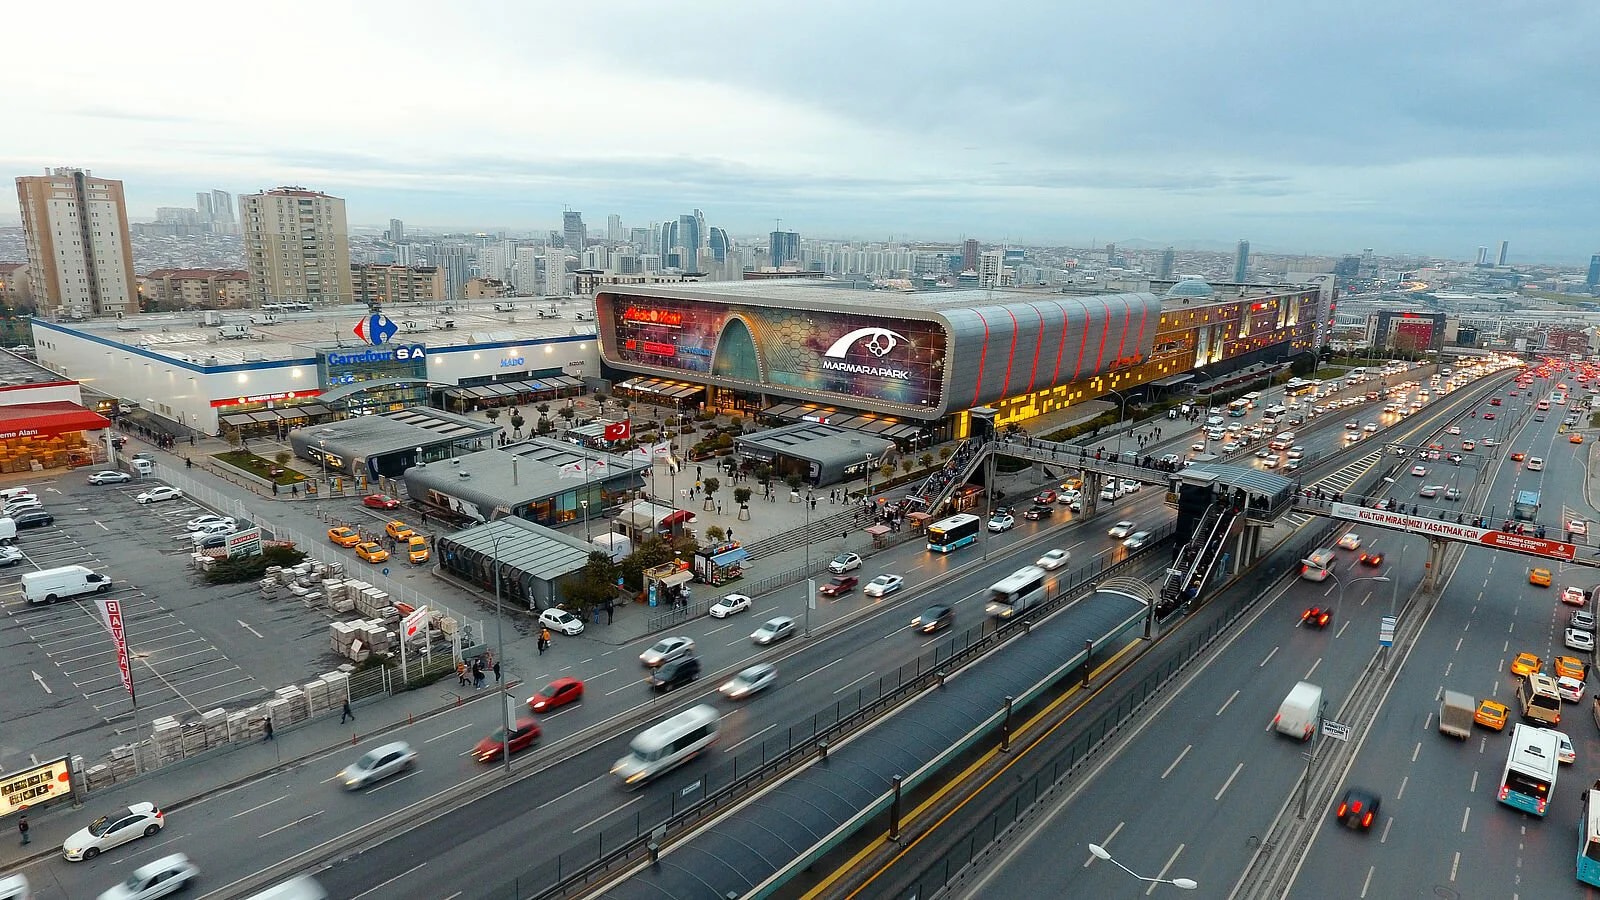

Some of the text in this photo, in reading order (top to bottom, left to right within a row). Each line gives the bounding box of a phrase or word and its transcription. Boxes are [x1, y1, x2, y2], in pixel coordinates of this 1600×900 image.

[328, 350, 393, 366] Carrefour
[1358, 510, 1385, 522] KÜLTÜR
[1385, 515, 1423, 529] MİRASMIZI
[1423, 521, 1463, 537] YAŞATMAK
[1463, 529, 1479, 539] İÇİN
